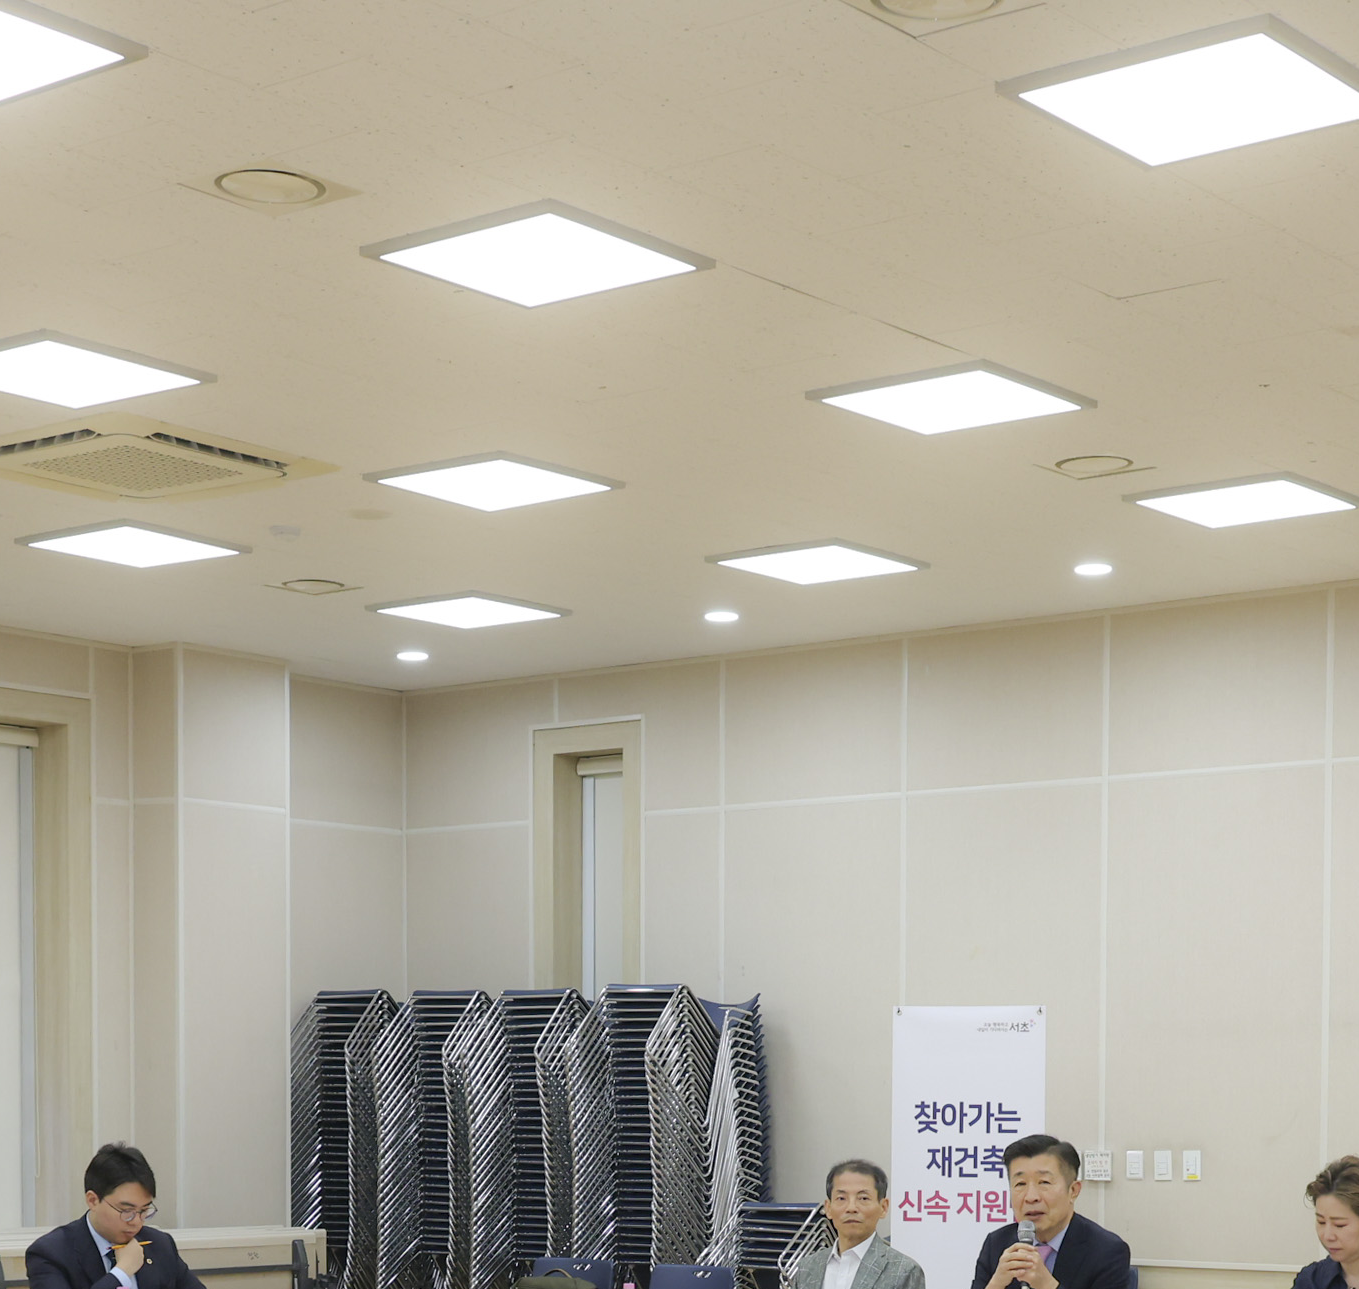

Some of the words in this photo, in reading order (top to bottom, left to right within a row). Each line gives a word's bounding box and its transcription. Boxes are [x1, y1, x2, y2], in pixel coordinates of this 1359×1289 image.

[1009, 1021, 1030, 1033] 서초
[914, 1101, 1021, 1134] 찾아가는
[926, 1146, 1005, 1179] 재건축
[898, 1190, 951, 1223] 신속
[957, 1190, 1019, 1223] 지원
